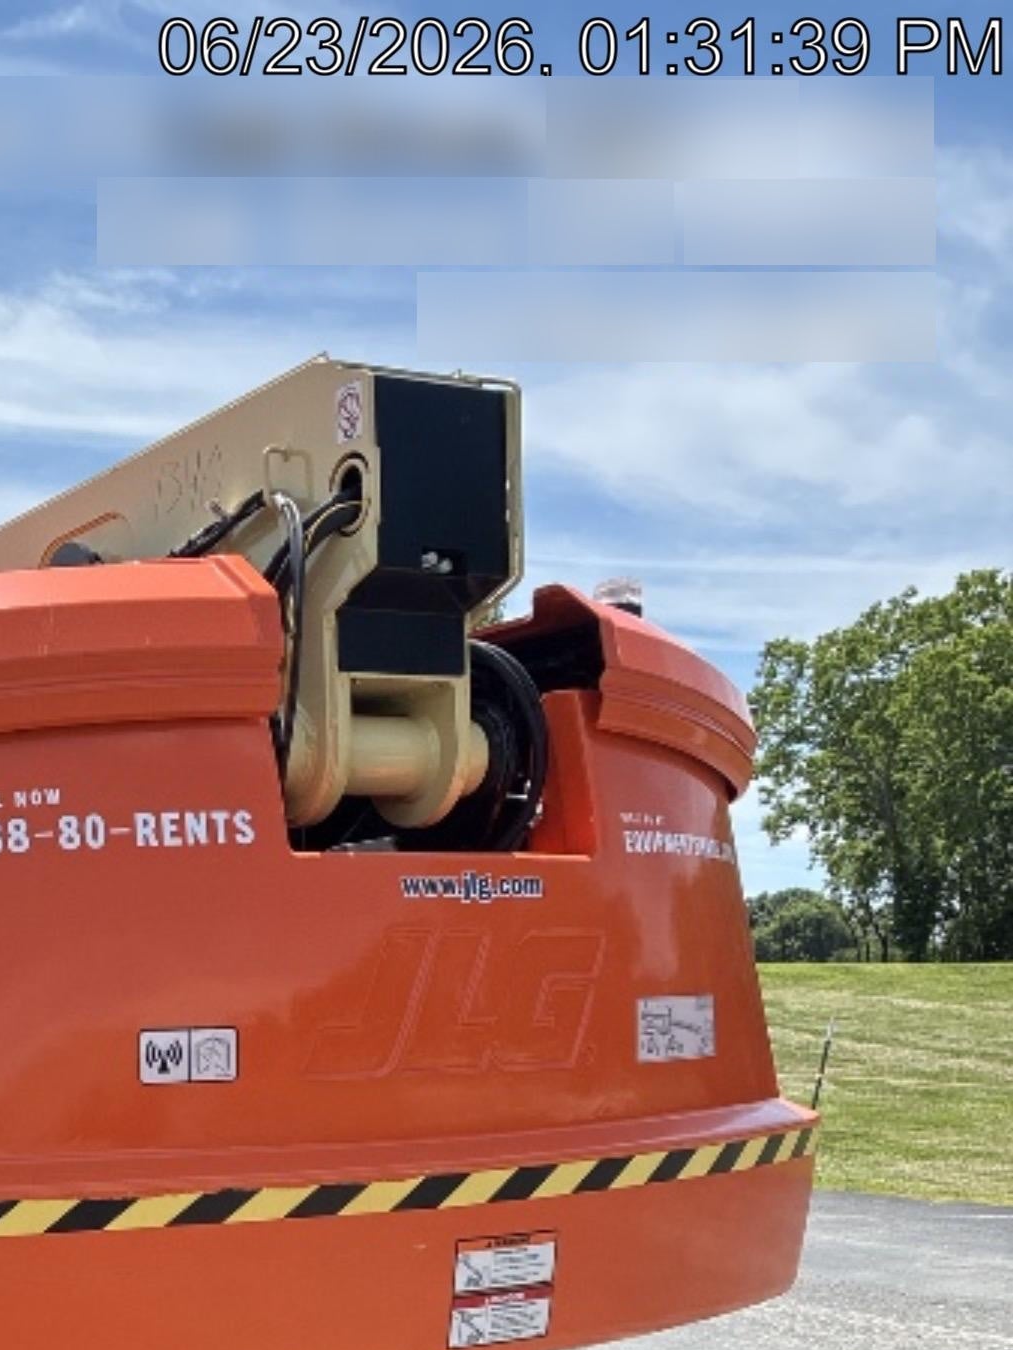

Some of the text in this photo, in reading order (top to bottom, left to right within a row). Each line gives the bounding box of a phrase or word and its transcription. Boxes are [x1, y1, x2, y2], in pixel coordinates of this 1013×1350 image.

[13, 788, 61, 807] NOW
[401, 871, 543, 903] www.jlg.com
[299, 926, 607, 1081] JLG
